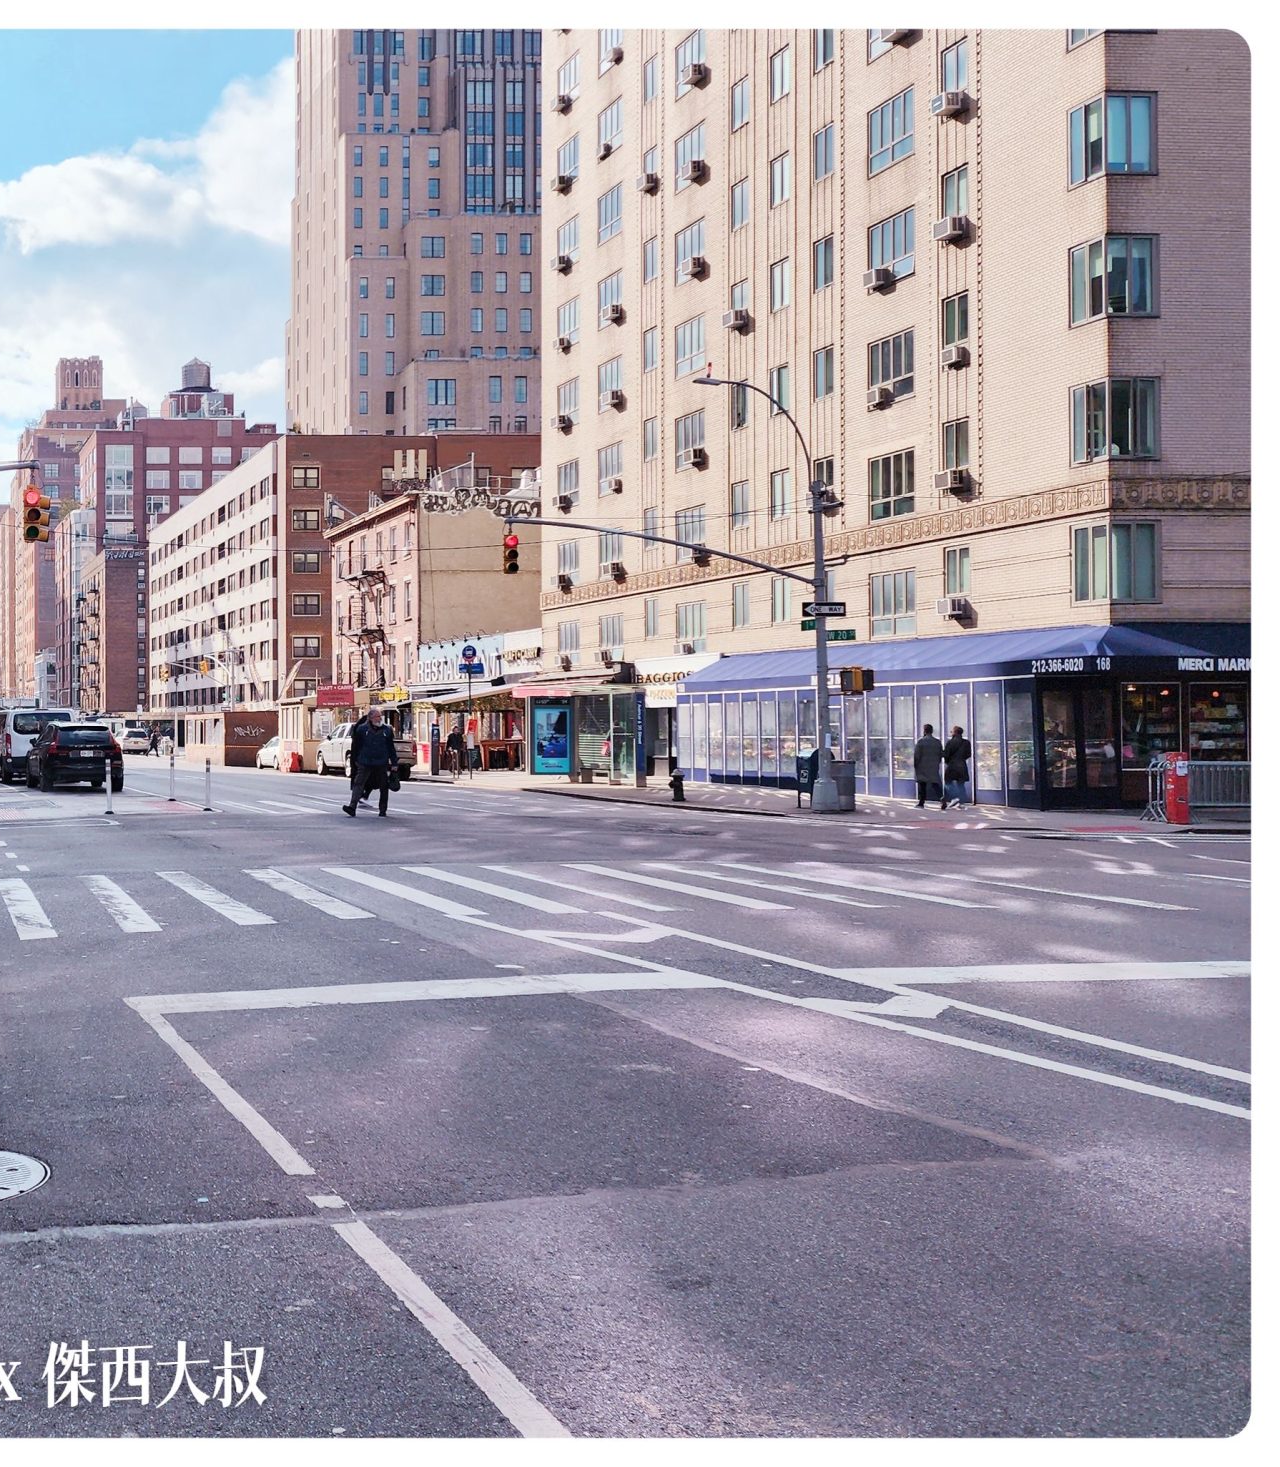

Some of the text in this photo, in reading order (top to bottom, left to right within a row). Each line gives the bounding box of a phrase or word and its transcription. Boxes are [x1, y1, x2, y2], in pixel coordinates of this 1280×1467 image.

[838, 630, 847, 640] 20
[417, 652, 501, 681] RESTAUNT
[1031, 657, 1111, 673] 212-366-6020 168
[1177, 657, 1252, 671] MERCI MARK
